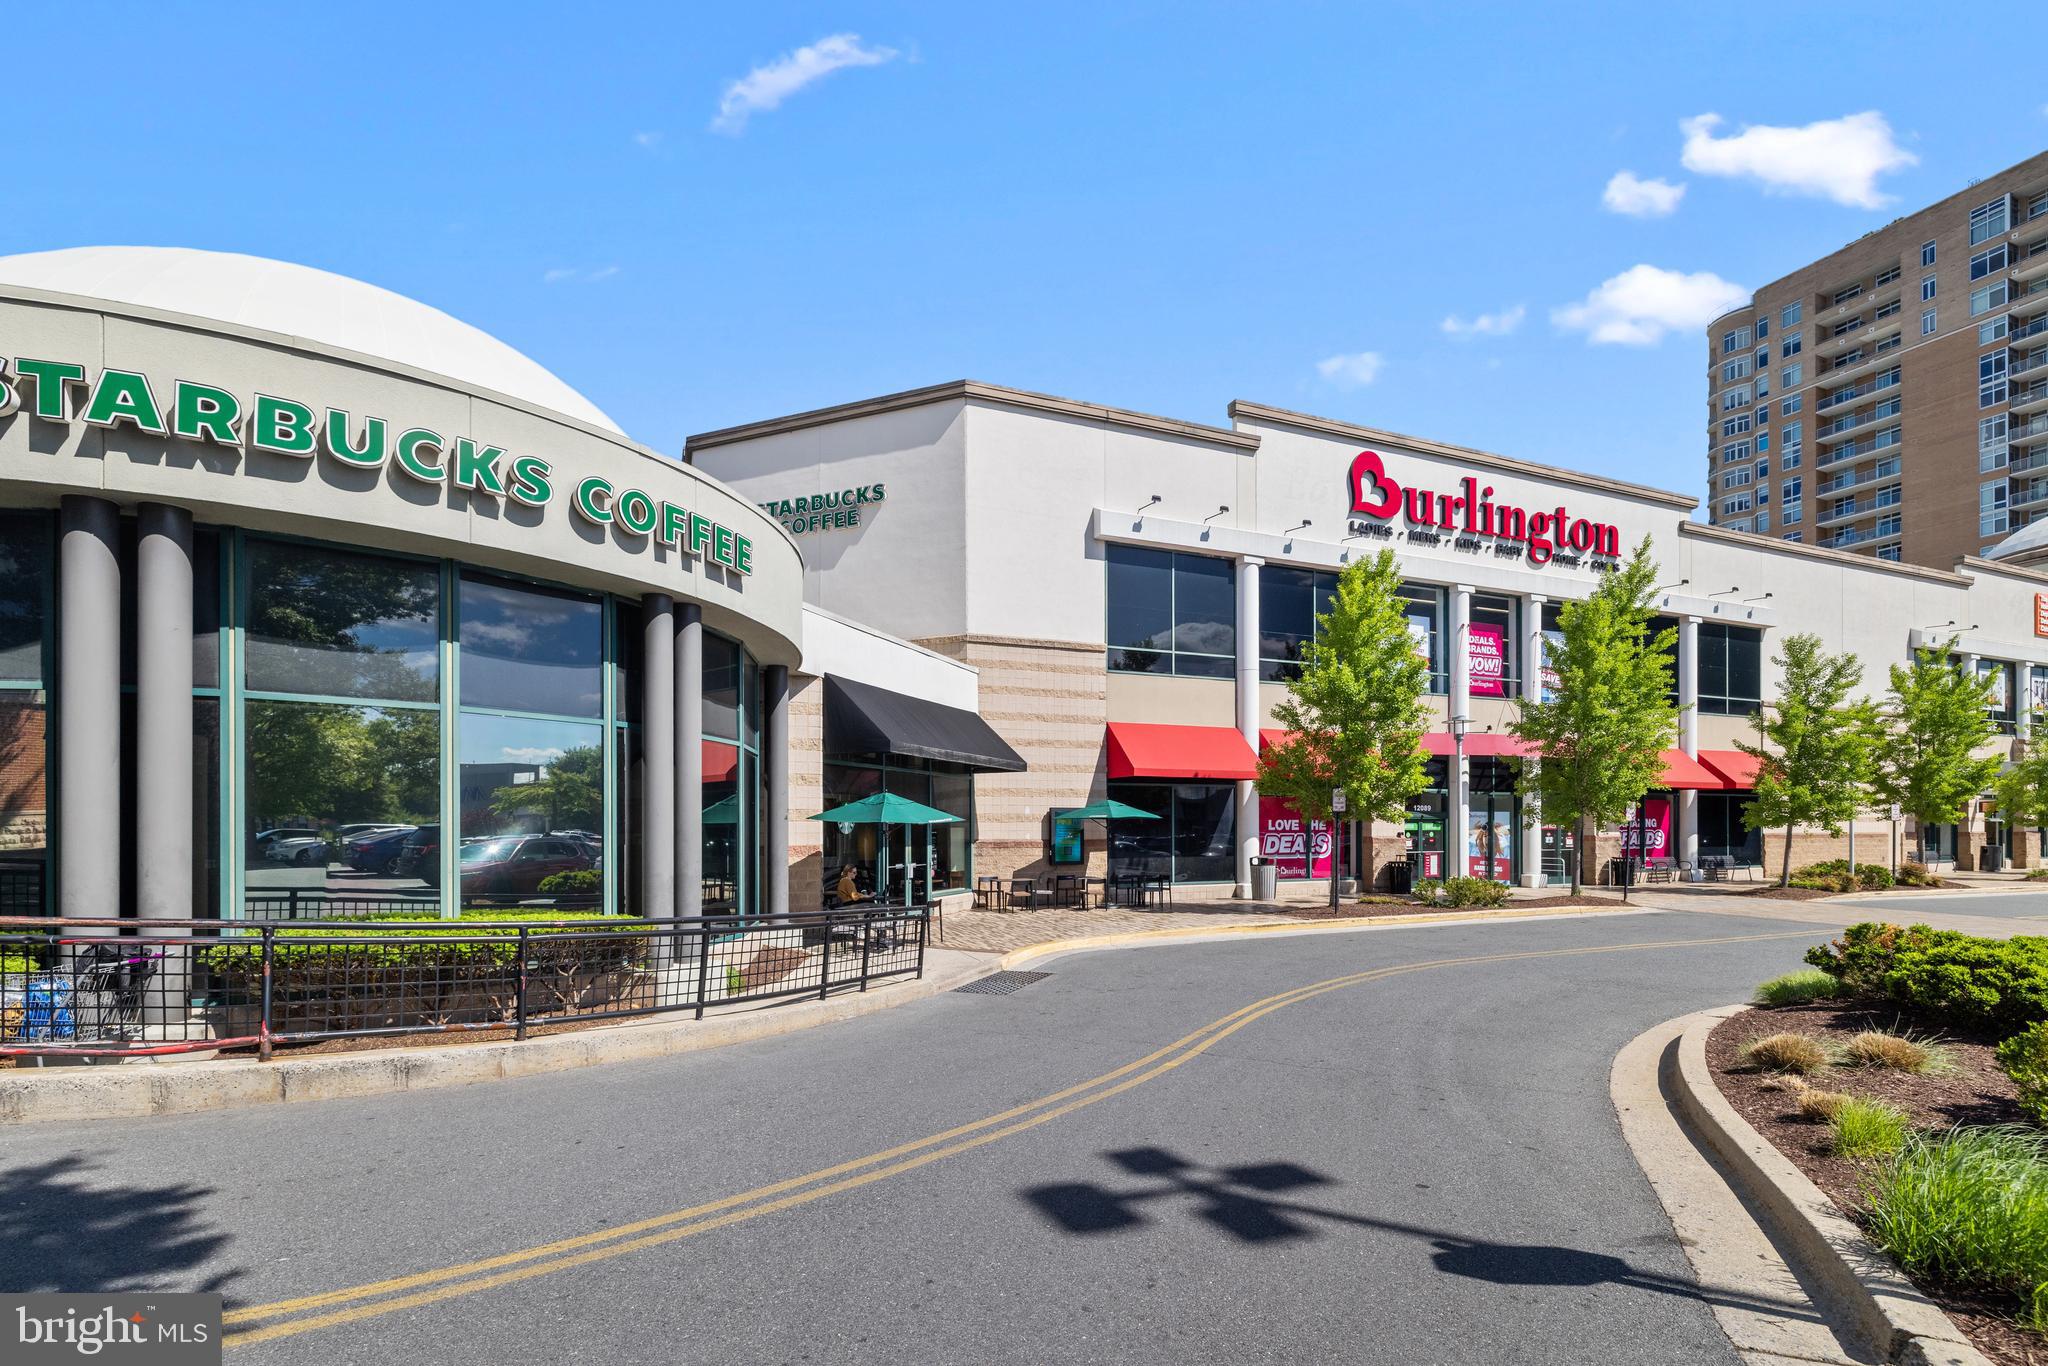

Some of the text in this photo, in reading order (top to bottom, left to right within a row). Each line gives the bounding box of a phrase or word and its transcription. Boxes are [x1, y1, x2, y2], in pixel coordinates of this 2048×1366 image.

[0, 356, 755, 577] TARBUCKS COFFEE
[1349, 450, 1622, 564] Burlington
[1349, 520, 1393, 538] LADIES
[1408, 529, 1442, 545] MENS
[1455, 537, 1482, 551] KIDS
[1495, 543, 1524, 558] BABY
[1552, 552, 1580, 566] HOME
[1268, 819, 1300, 831] LOVE
